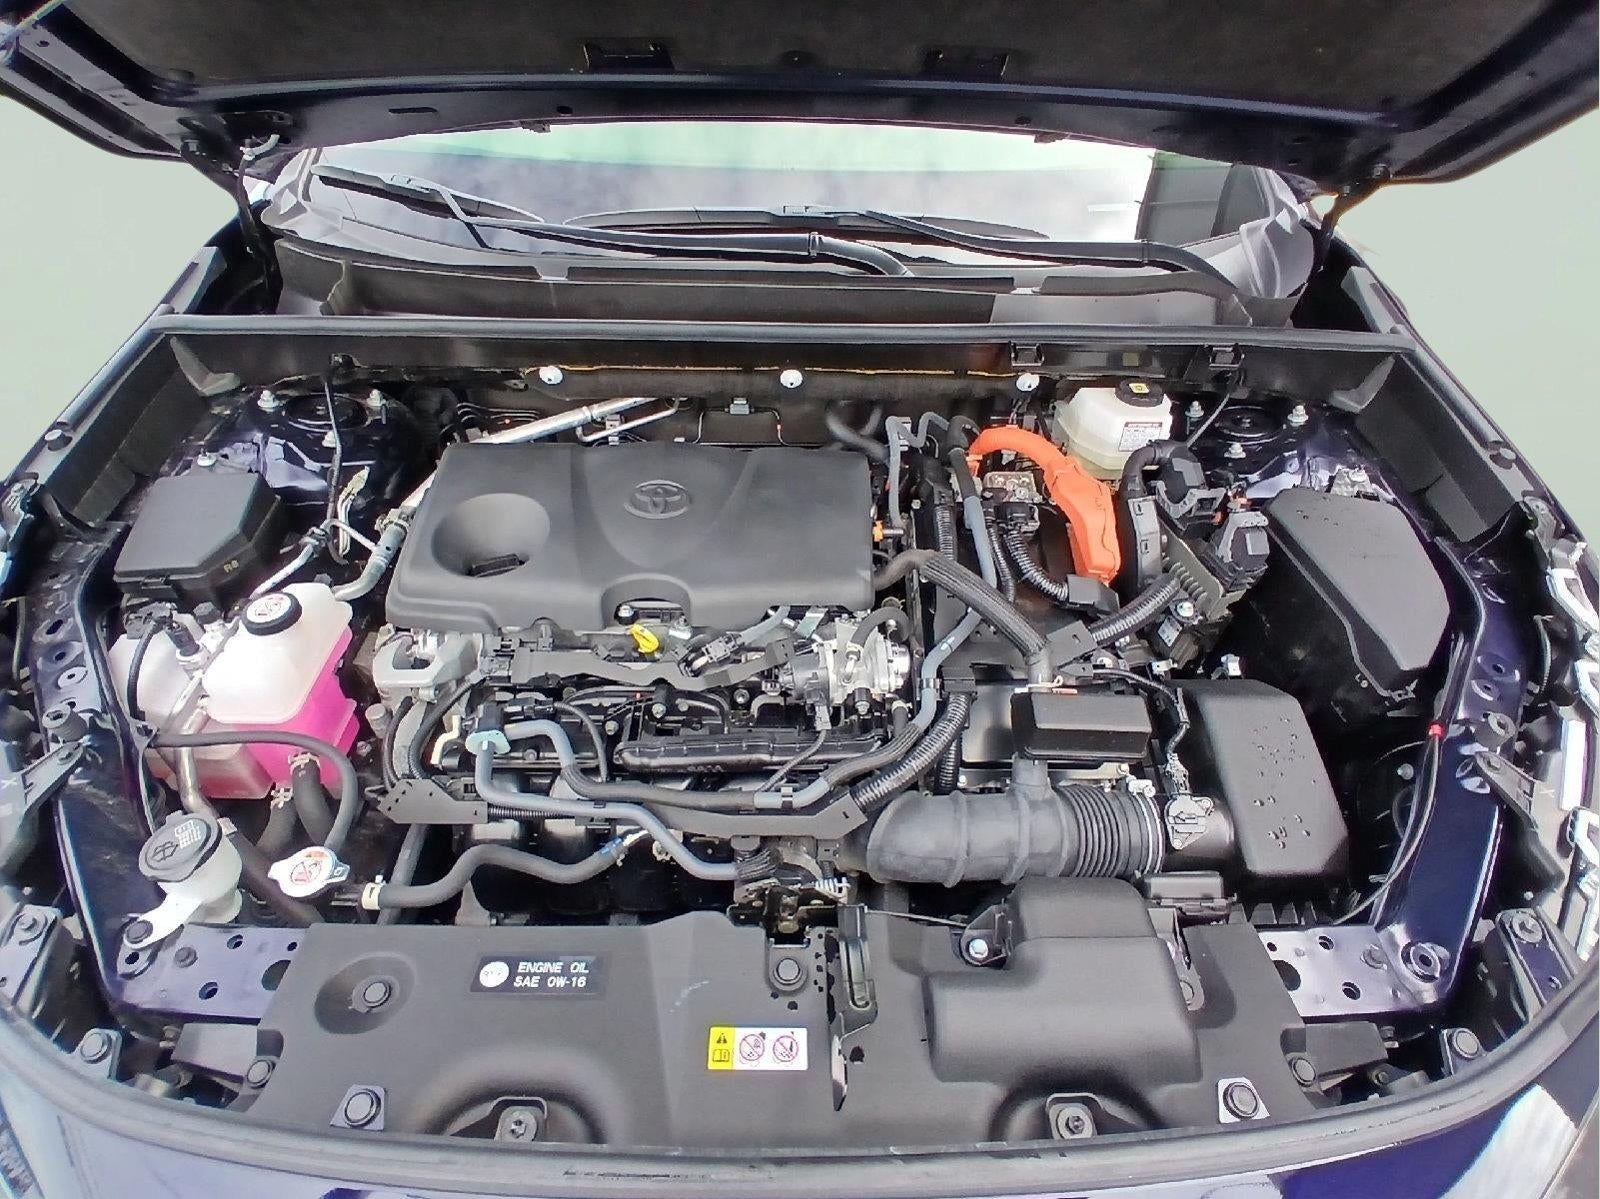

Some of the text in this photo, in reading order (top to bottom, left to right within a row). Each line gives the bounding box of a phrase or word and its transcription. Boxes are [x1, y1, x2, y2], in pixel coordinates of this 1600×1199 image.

[517, 962, 589, 973] ENGINE OIL
[513, 976, 586, 988] SAE 0W-16
